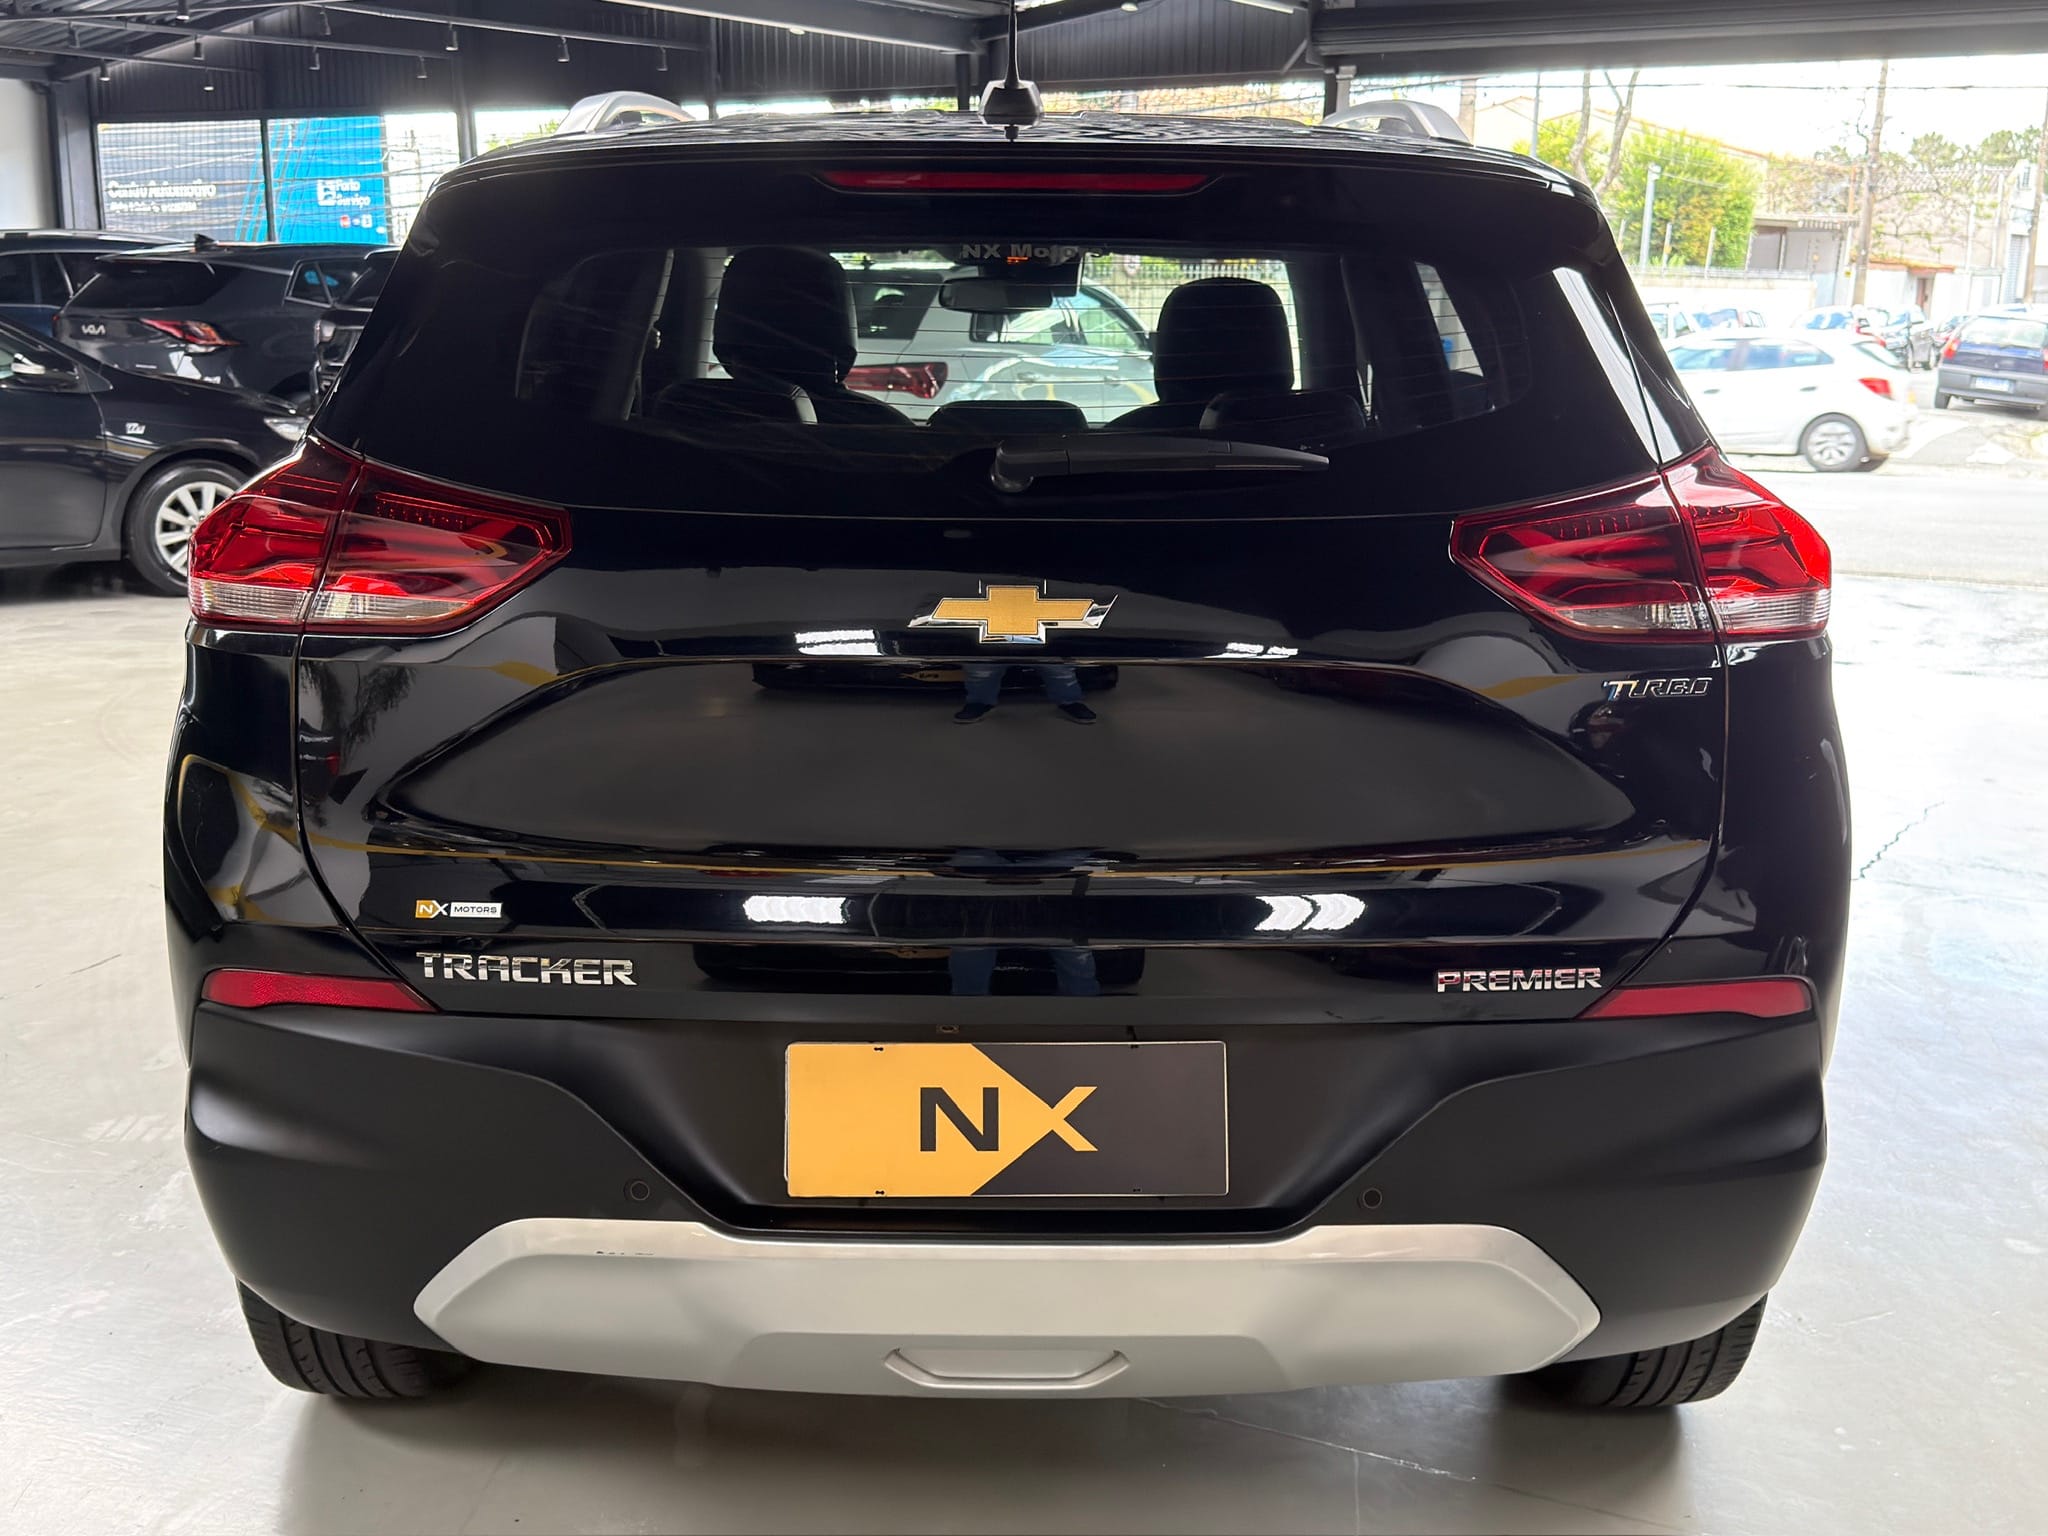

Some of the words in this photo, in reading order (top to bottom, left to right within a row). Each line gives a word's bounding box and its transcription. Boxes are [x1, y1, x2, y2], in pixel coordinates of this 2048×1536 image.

[961, 244, 1001, 259] NX
[1603, 677, 1712, 701] TURBO
[418, 901, 449, 917] NX
[453, 905, 498, 914] MOTORS
[416, 952, 637, 985] TRACKER
[1437, 967, 1602, 993] PREMIER
[919, 1086, 1099, 1152] NX
